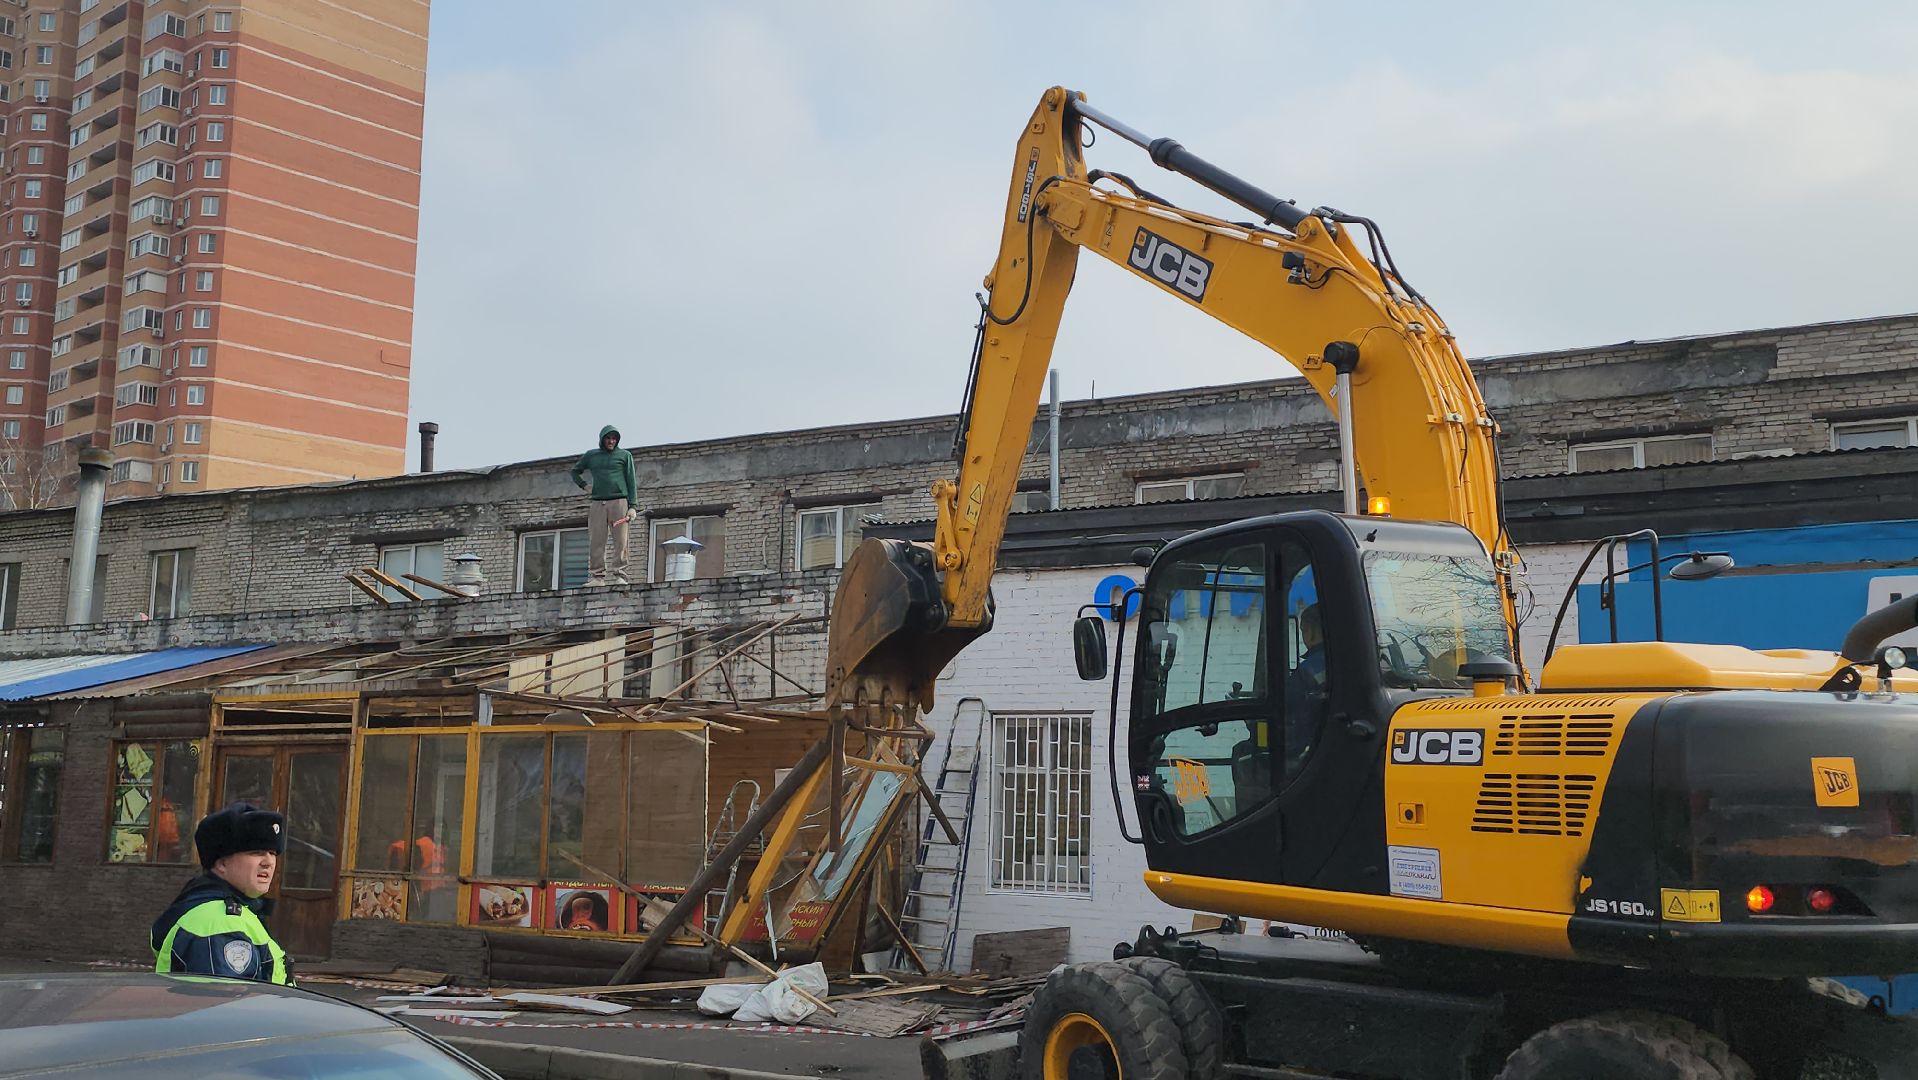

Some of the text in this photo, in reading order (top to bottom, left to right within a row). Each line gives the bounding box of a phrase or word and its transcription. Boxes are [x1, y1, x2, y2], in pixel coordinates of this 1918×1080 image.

[1131, 235, 1209, 298] JCB
[1393, 731, 1482, 763] JCB
[1823, 770, 1851, 793] JCB
